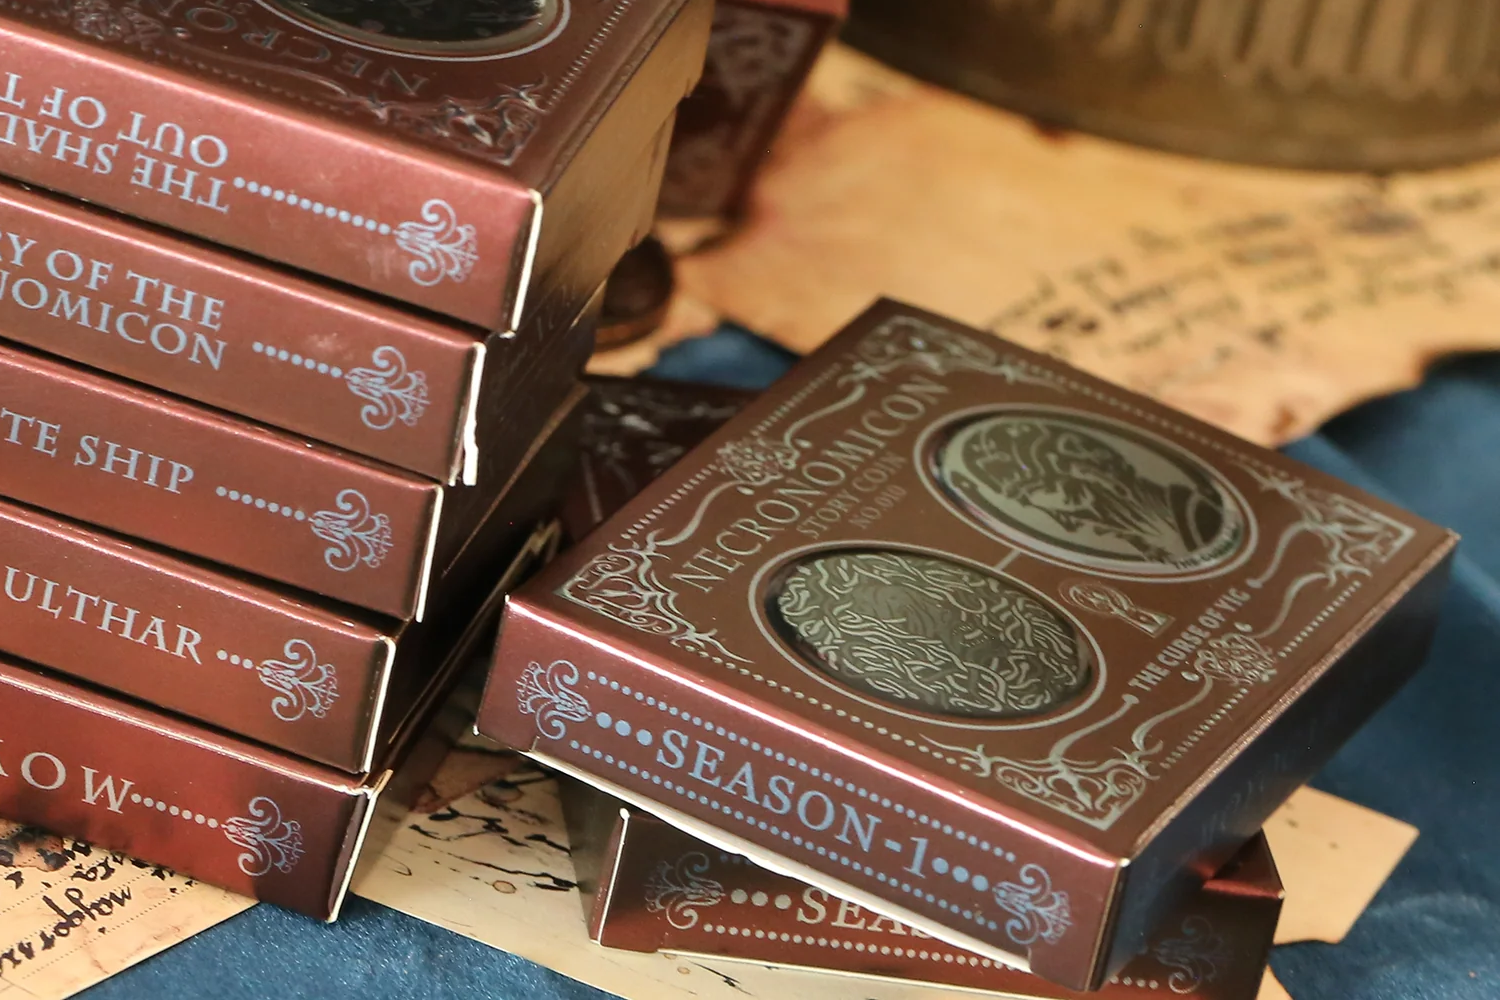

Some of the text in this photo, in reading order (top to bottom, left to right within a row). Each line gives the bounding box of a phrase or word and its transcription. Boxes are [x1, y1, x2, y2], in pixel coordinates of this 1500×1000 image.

[39, 87, 107, 129] OF
[116, 111, 229, 168] OUT
[131, 152, 230, 214] THE
[45, 248, 115, 292] OF
[125, 269, 226, 332] THE
[73, 434, 196, 495] SHIP
[670, 374, 949, 593] NECRONOMICON
[796, 451, 908, 540] STORY COIN
[3, 564, 204, 665] ULTHAR
[1128, 661, 1172, 693] THE
[1156, 623, 1212, 667] CURSE
[1198, 607, 1226, 630] OF
[654, 729, 931, 880] SEASON-1
